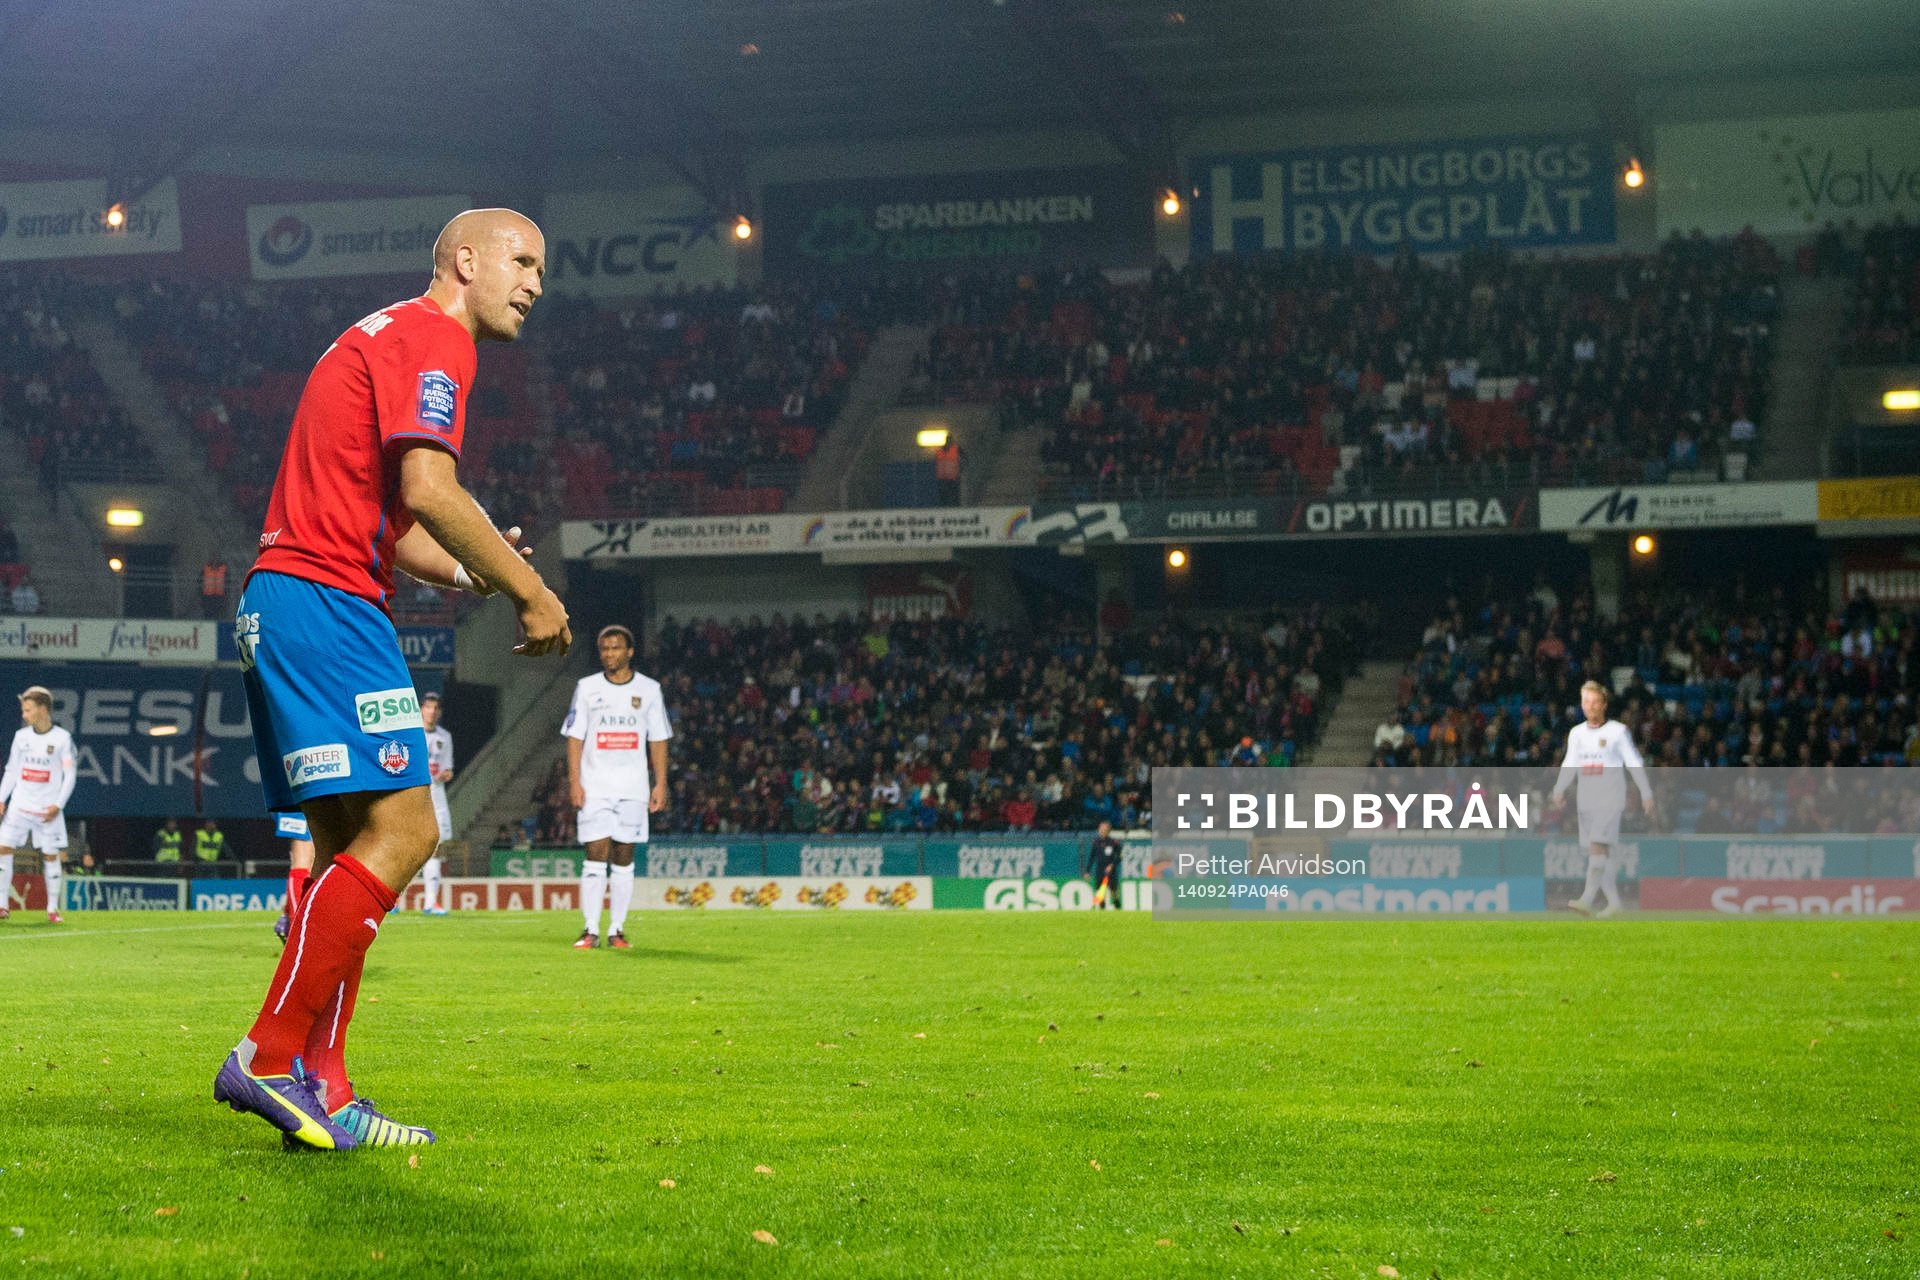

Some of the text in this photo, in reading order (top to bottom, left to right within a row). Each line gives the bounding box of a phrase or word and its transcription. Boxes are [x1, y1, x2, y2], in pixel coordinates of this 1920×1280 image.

[16, 206, 161, 239] smart sfety
[875, 195, 1093, 230] SPARBANKEN
[1294, 180, 1592, 249] BYGGPLÅT
[320, 230, 386, 257] smart
[551, 232, 681, 279] NCC
[1305, 497, 1508, 532] OPTIMERA
[101, 622, 199, 658] feelgood
[301, 750, 341, 766] INTER
[303, 762, 341, 776] SPORT
[506, 859, 576, 878] SEB
[647, 861, 728, 878] KRAFT
[802, 861, 884, 878] KRAFT
[958, 860, 1044, 877] KRAFT
[1369, 860, 1461, 877] KRAFT
[1727, 860, 1824, 878] KRAFT
[1712, 886, 1903, 914] Scandic
